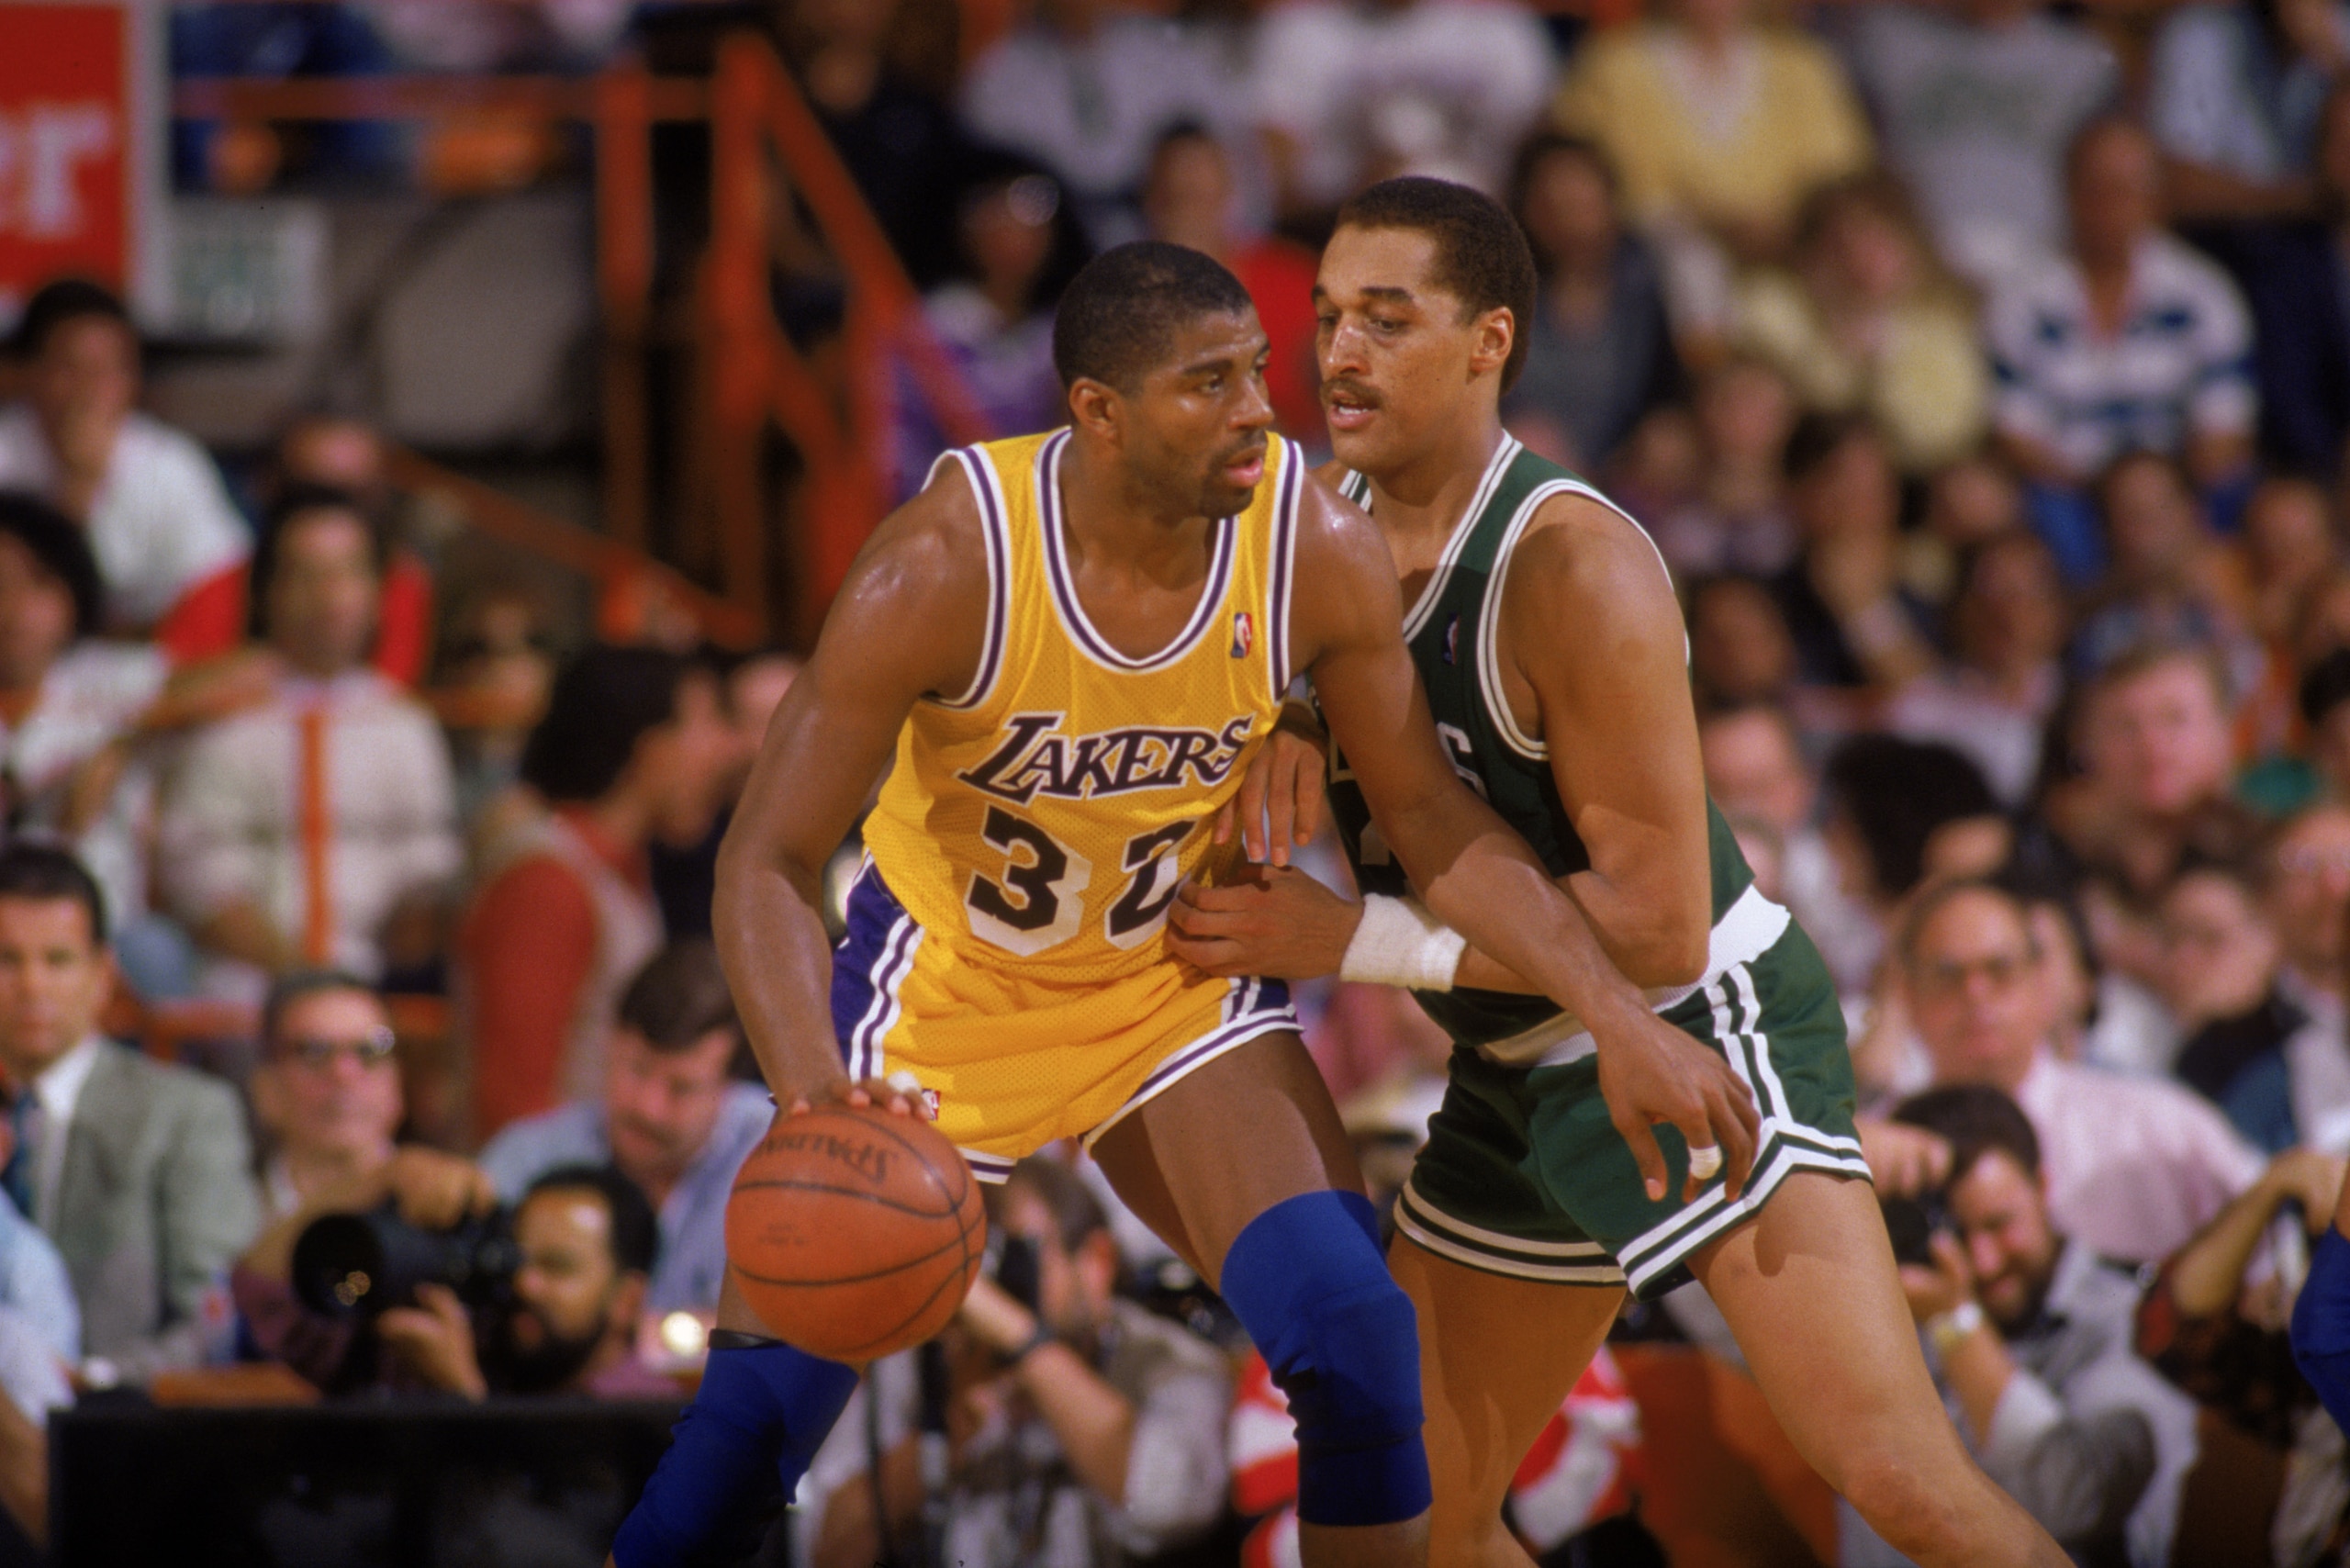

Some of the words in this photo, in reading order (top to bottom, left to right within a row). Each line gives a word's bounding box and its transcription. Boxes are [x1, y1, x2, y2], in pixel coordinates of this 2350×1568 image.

[0, 106, 111, 239] r
[955, 711, 1255, 807] LAKERS
[964, 801, 1199, 957] 32
